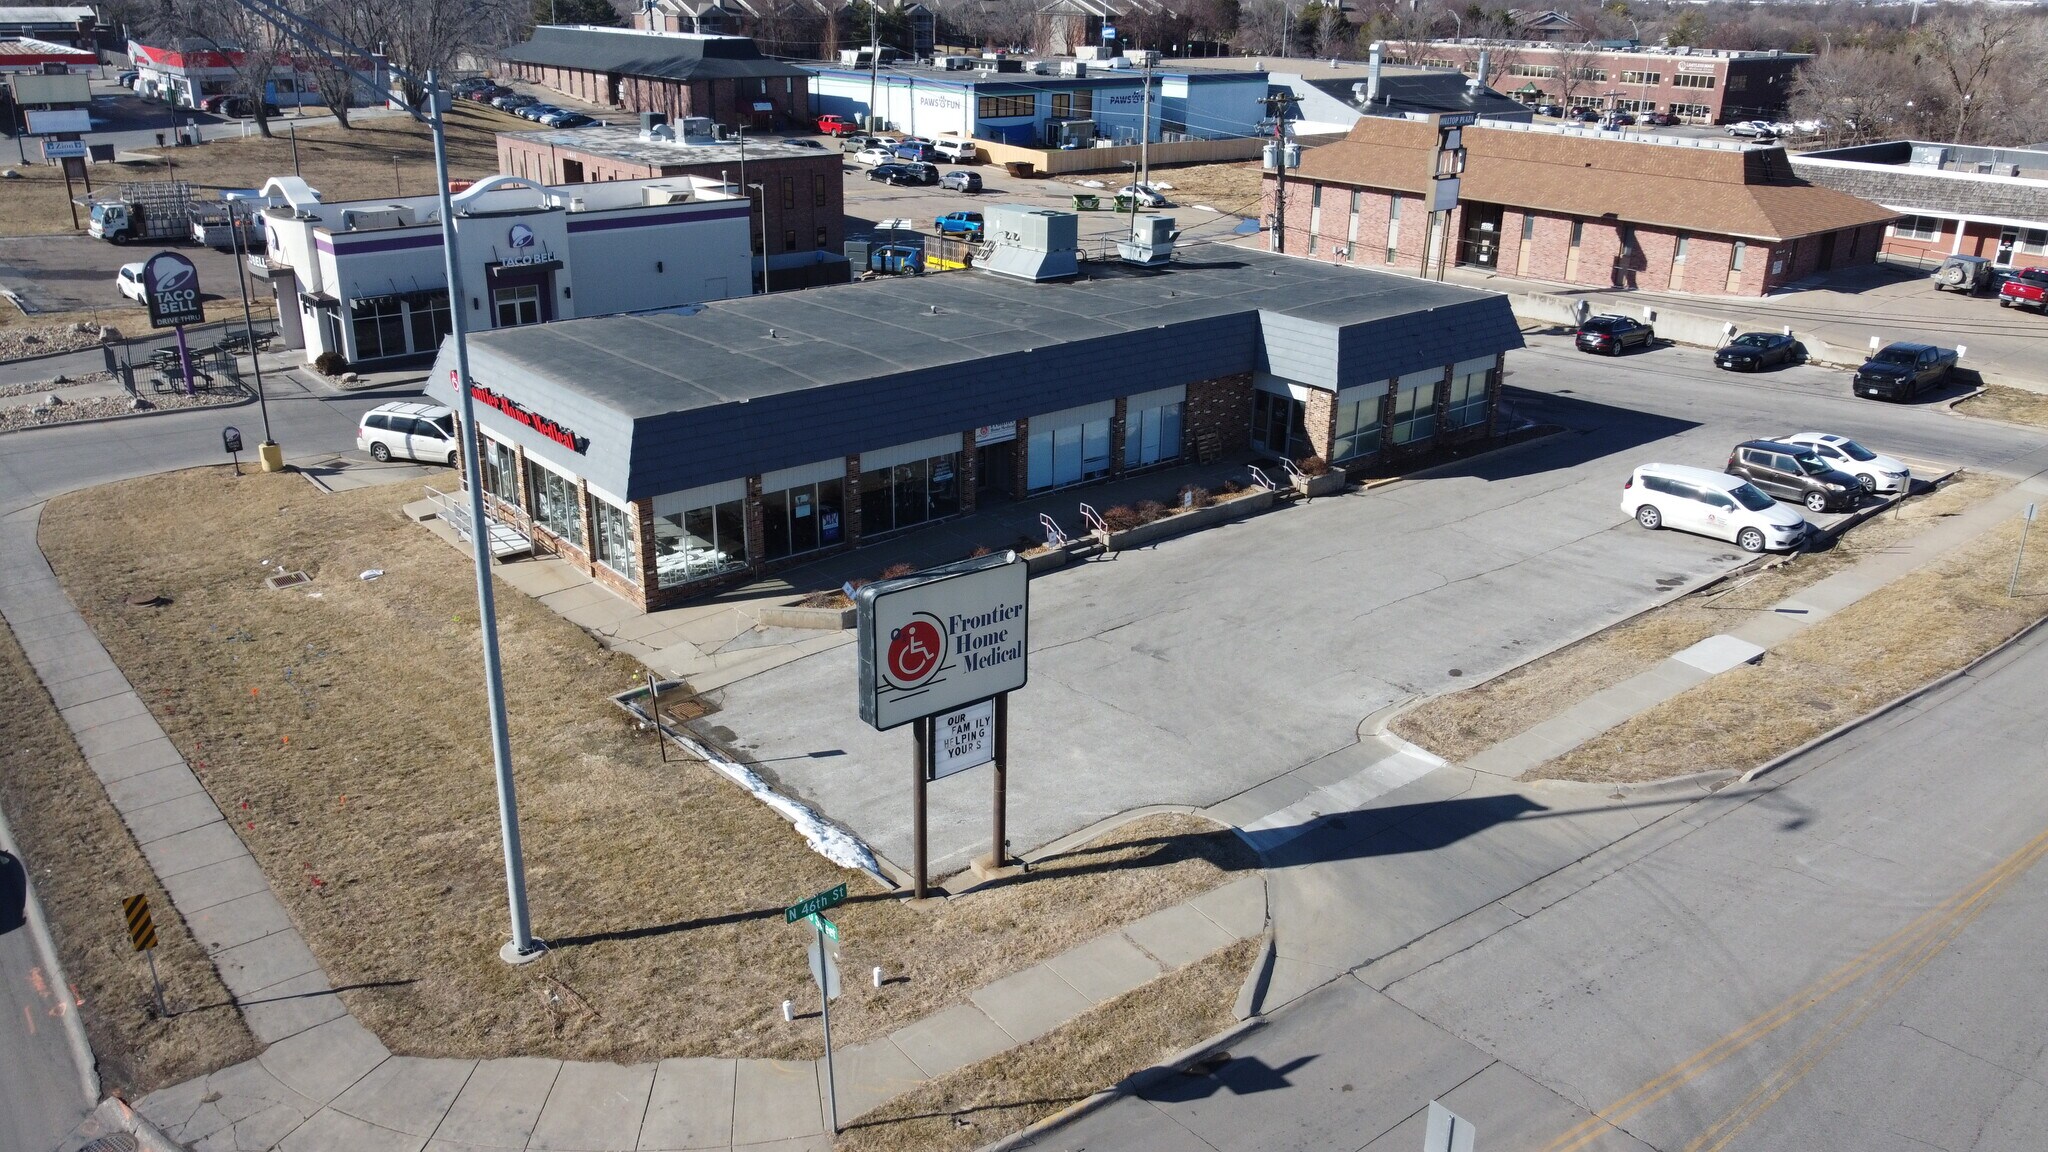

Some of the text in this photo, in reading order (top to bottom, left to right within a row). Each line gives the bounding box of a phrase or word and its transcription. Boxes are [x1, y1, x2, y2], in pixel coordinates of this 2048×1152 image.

[920, 97, 960, 109] PAWS FUN
[1110, 95, 1155, 104] PAWS FN
[500, 252, 558, 267] TACO BELL
[154, 289, 195, 303] TACO
[159, 301, 197, 314] BELL
[157, 314, 200, 325] DRIVE THRU
[500, 397, 531, 427] Home
[532, 412, 576, 452] Medical
[949, 604, 1022, 635] Frontier
[956, 629, 1008, 654] Home
[963, 641, 1021, 674] Medical
[947, 714, 966, 726] OUR
[789, 908, 797, 921] N
[801, 897, 827, 914] 46th
[832, 887, 844, 900] St
